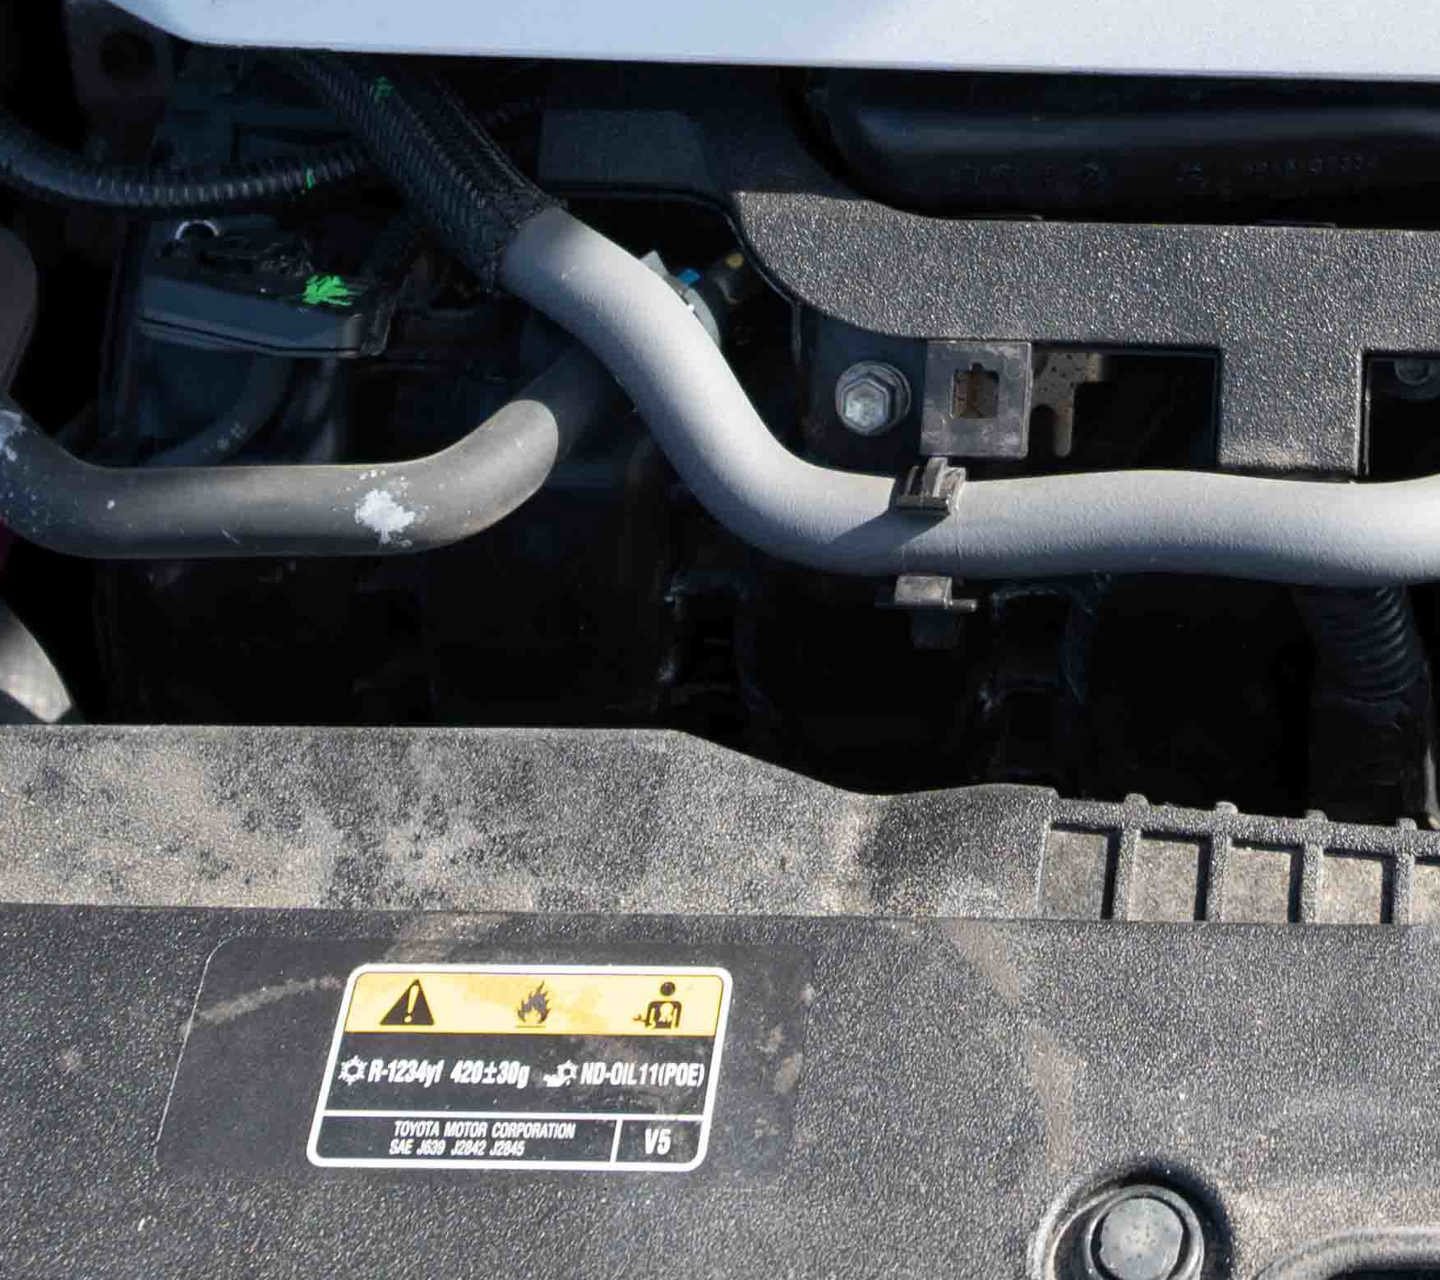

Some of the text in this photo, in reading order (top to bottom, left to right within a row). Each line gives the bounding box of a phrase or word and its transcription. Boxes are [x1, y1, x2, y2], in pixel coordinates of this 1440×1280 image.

[393, 1120, 576, 1140] TOYOTA MOTOR CORPORATION
[389, 1139, 413, 1156] SAE
[644, 1128, 672, 1156] V5
